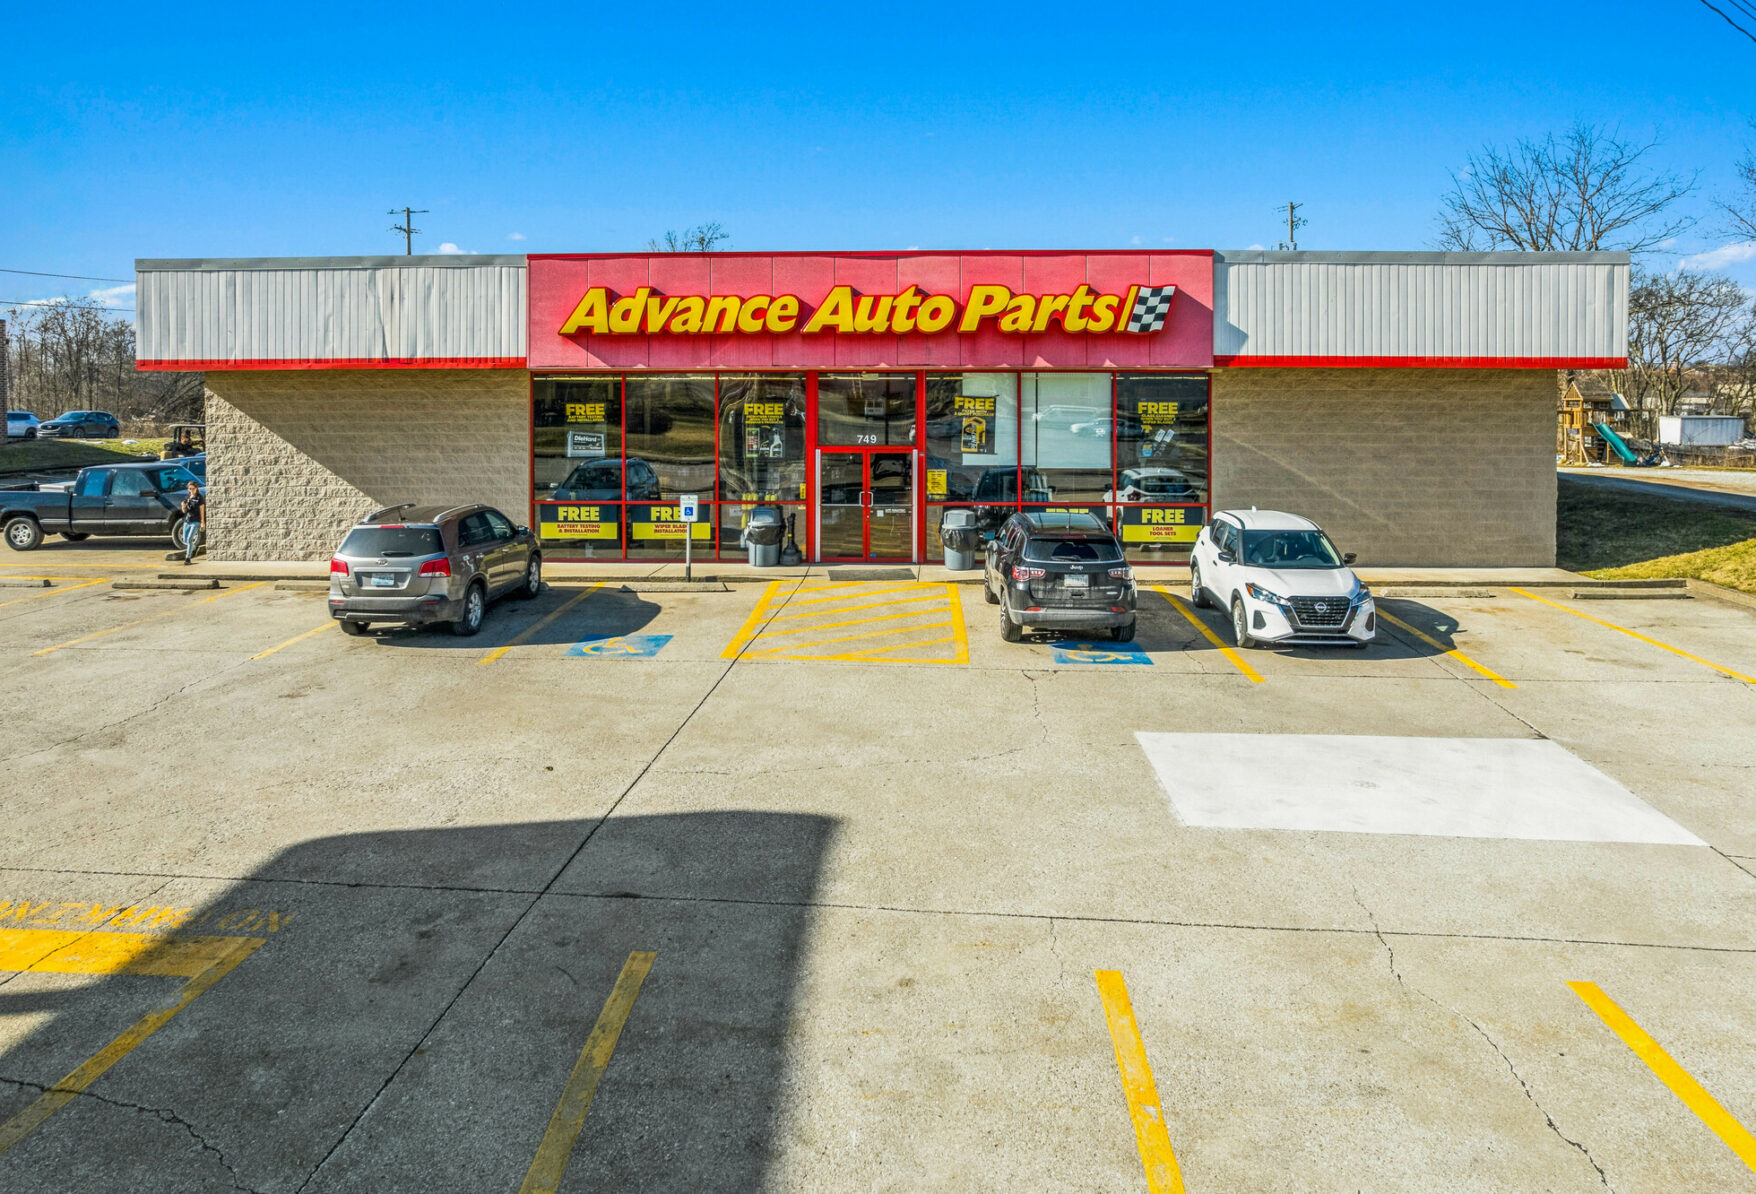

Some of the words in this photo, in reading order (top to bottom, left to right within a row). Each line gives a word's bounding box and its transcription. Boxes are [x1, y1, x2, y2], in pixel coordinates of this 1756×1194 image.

[558, 286, 799, 335] Advance
[801, 284, 955, 334] Auto
[958, 284, 1120, 334] Parts
[565, 403, 605, 415] FREE
[744, 403, 784, 415] FREE
[954, 397, 995, 410] FREE
[1137, 402, 1178, 414] FREE
[856, 434, 877, 444] 749
[558, 506, 600, 521] FREE
[650, 506, 681, 521] FRE
[1141, 508, 1185, 524] FREE
